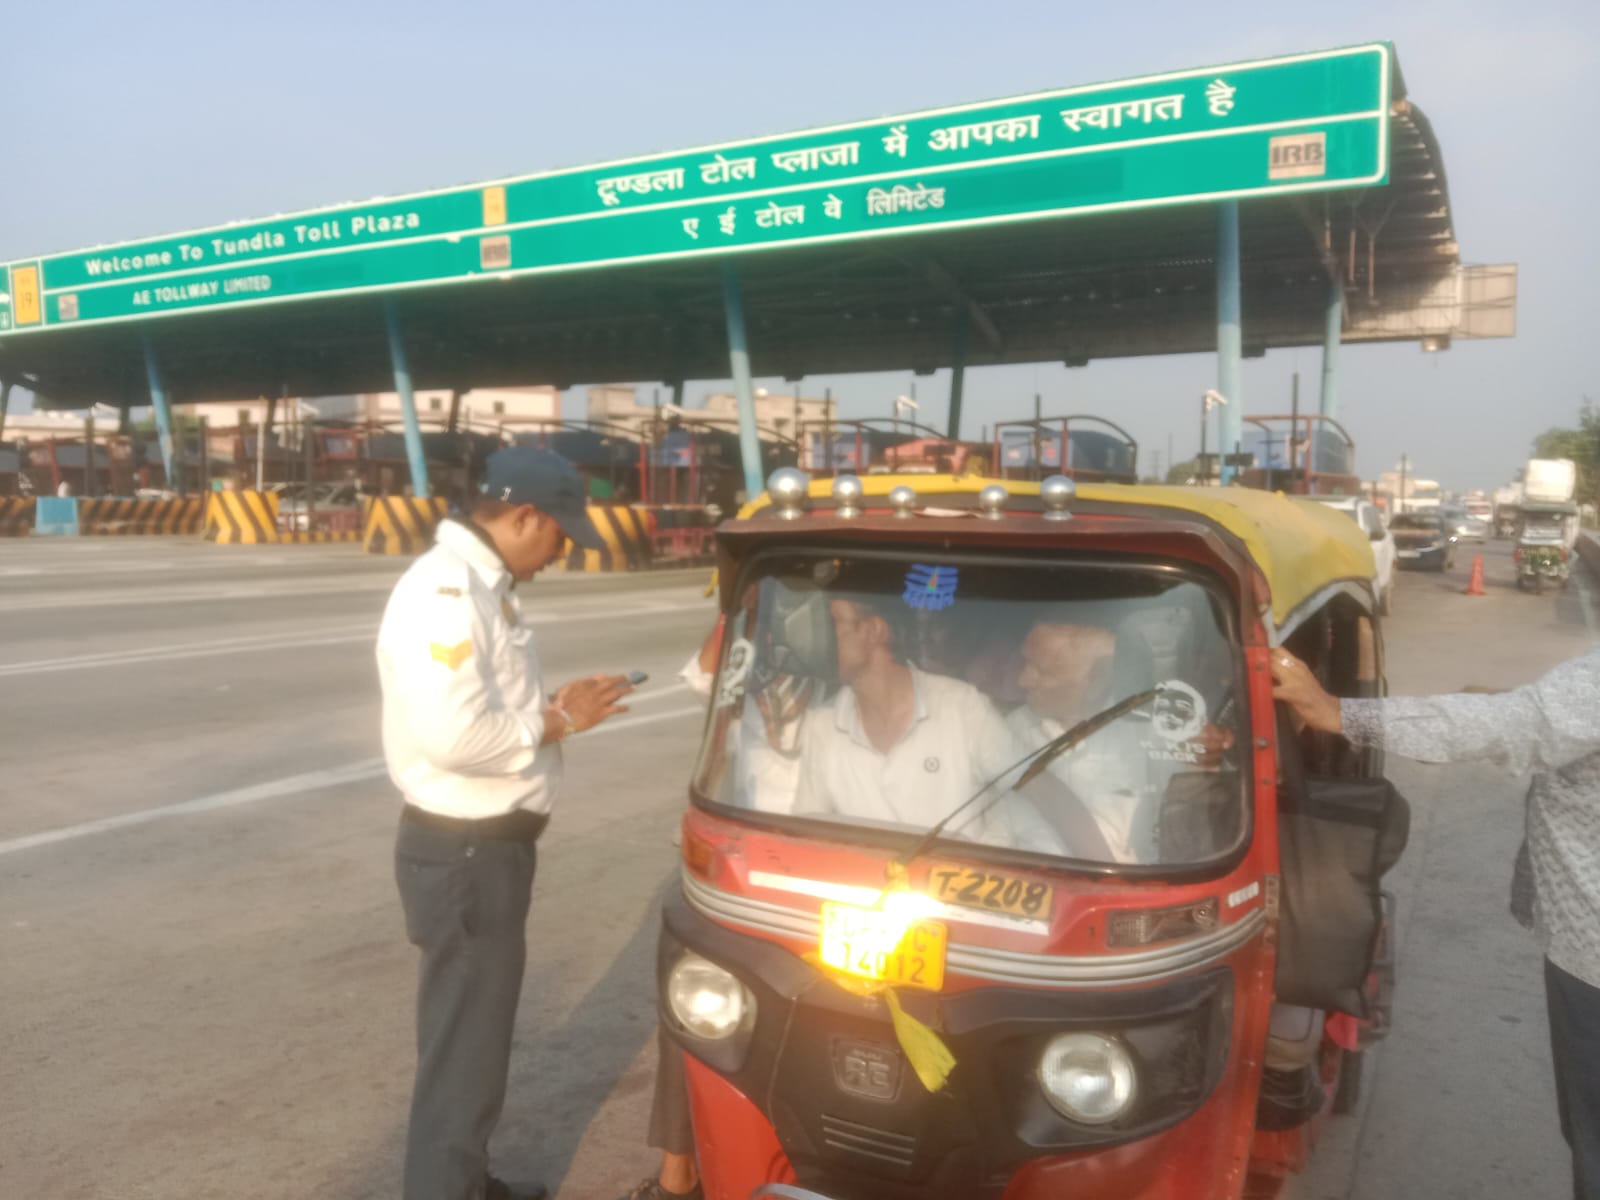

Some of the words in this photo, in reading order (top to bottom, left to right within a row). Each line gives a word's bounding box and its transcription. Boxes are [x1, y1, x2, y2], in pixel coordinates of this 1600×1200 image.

[595, 168, 685, 206] टूण्डला
[699, 154, 757, 185] टोल
[770, 141, 861, 173] प्लाजा
[882, 125, 909, 158] में
[927, 114, 1042, 151] आपका
[1060, 94, 1186, 132] स्वागत
[1205, 78, 1236, 116] है
[1271, 142, 1325, 165] IRB
[681, 217, 700, 239] ए
[717, 206, 737, 236] ई
[754, 202, 806, 229] टोल
[823, 193, 844, 219] वे
[865, 182, 946, 216] लिमिटेड
[85, 251, 172, 276] Welcome
[177, 244, 204, 261] To
[210, 230, 286, 256] Tundla
[293, 220, 342, 244] Toll
[350, 212, 420, 236] Plaza
[132, 289, 152, 306] AE
[154, 280, 219, 303] TOLLWAY
[223, 274, 273, 294] LIMITED
[935, 866, 1049, 915] T-2208
